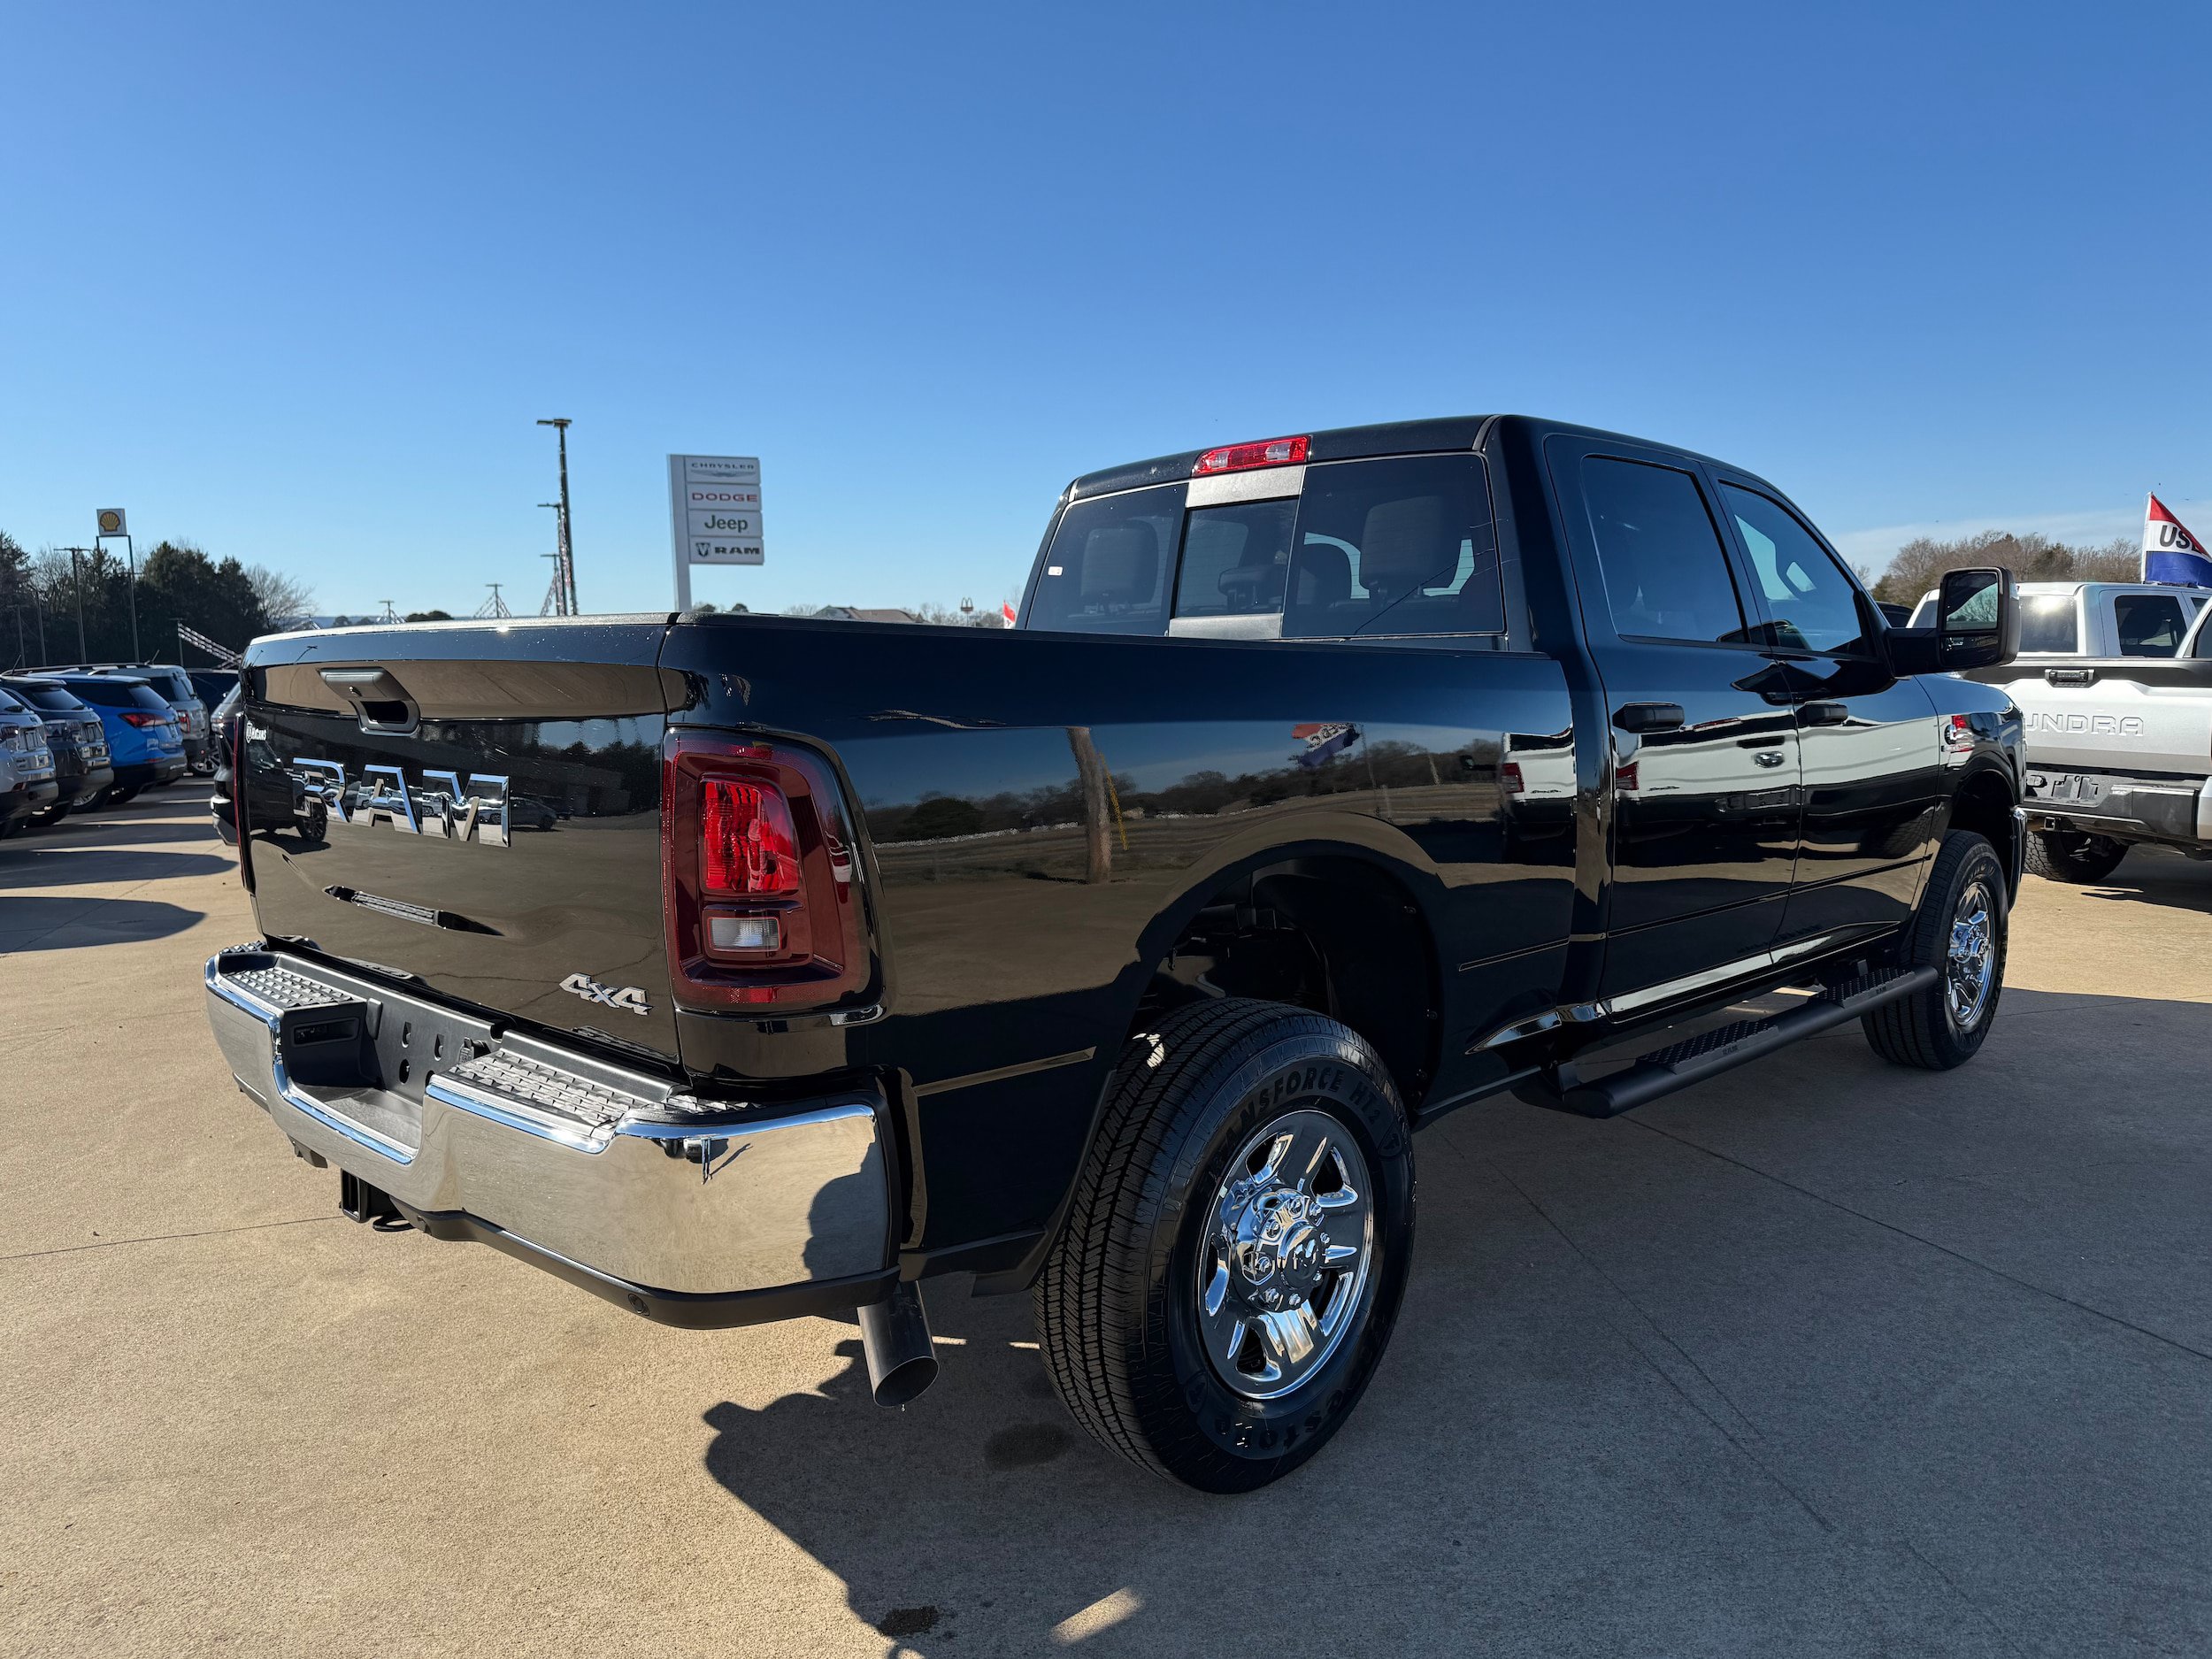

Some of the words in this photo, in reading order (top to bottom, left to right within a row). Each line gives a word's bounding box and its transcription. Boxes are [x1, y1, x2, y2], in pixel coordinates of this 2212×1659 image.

[691, 492, 758, 503] DODGE
[704, 514, 749, 533] Jeep
[714, 546, 760, 555] RAM
[293, 757, 511, 849] RAM
